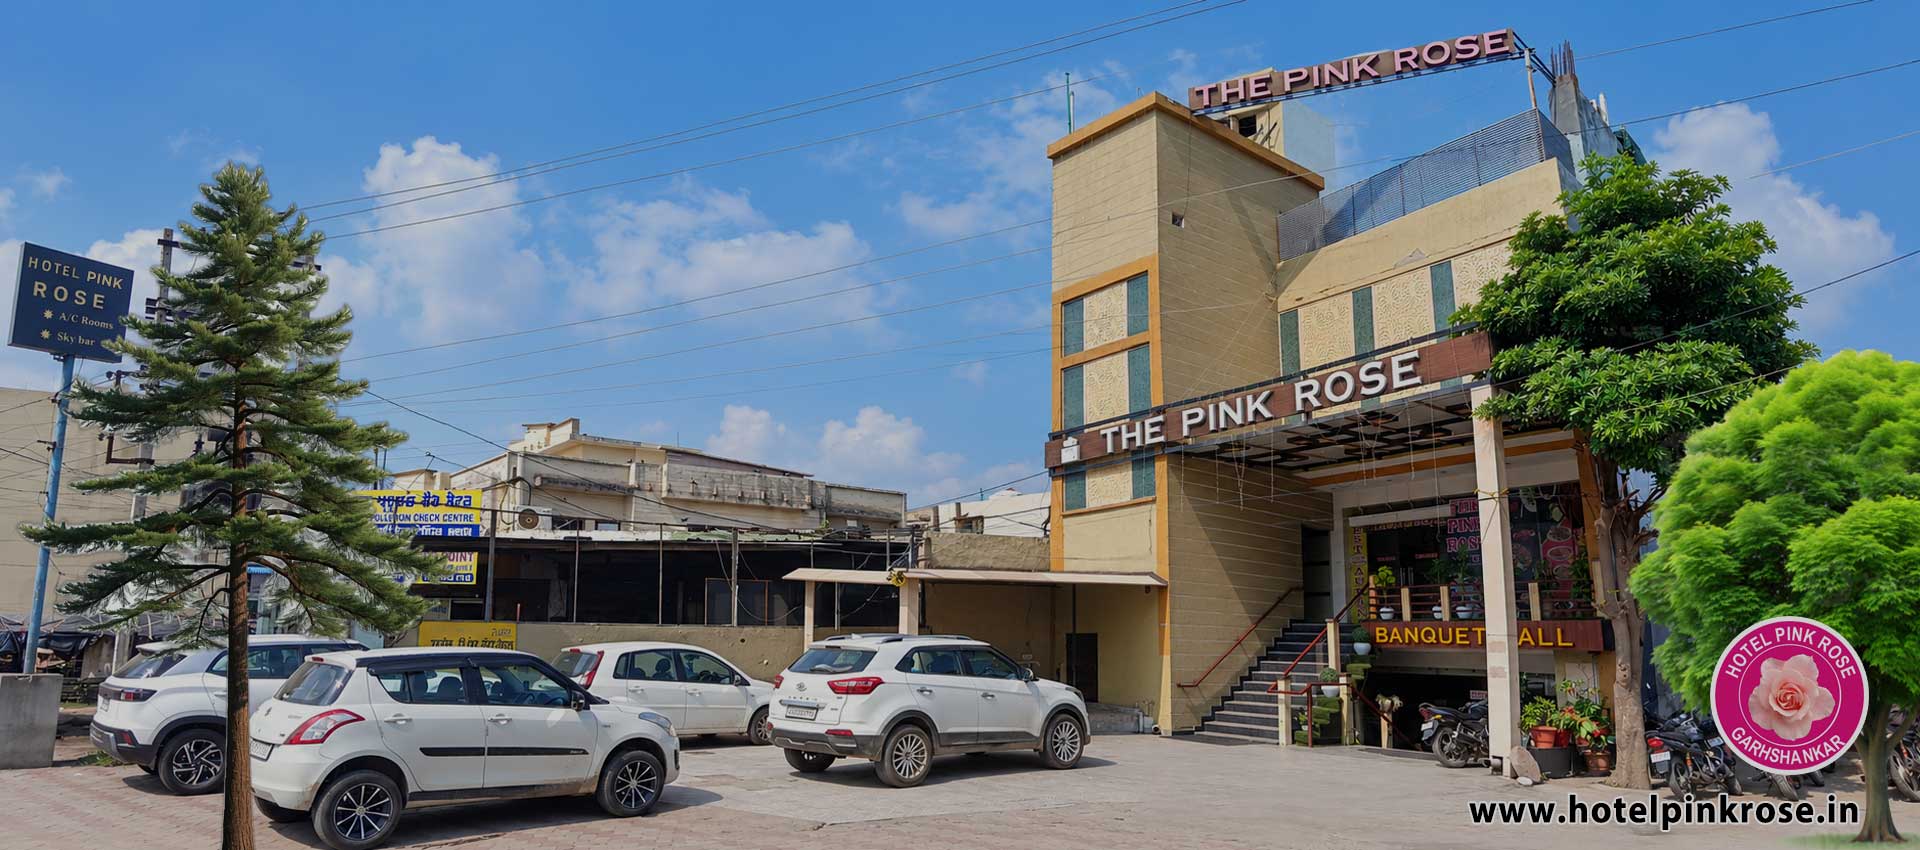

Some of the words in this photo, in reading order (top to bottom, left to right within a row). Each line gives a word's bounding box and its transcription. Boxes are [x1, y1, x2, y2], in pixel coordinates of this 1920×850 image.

[1194, 73, 1273, 110] THE
[1282, 52, 1379, 94] PINK
[1394, 29, 1511, 73] ROSE
[28, 256, 81, 279] HOTEL
[86, 271, 124, 290] PINK
[33, 281, 106, 310] ROSE
[59, 312, 79, 323] A/C
[81, 315, 114, 330] Rooms
[57, 332, 76, 345] Sky
[78, 335, 96, 347] bar
[1100, 414, 1167, 455] THE
[1181, 389, 1275, 437] PINK
[1294, 349, 1424, 413] ROSE
[413, 513, 440, 522] CHECK
[442, 513, 474, 522] CENTRE
[1447, 517, 1480, 533] PIN
[1375, 626, 1486, 646] BANQUET
[1518, 627, 1574, 647] ALL
